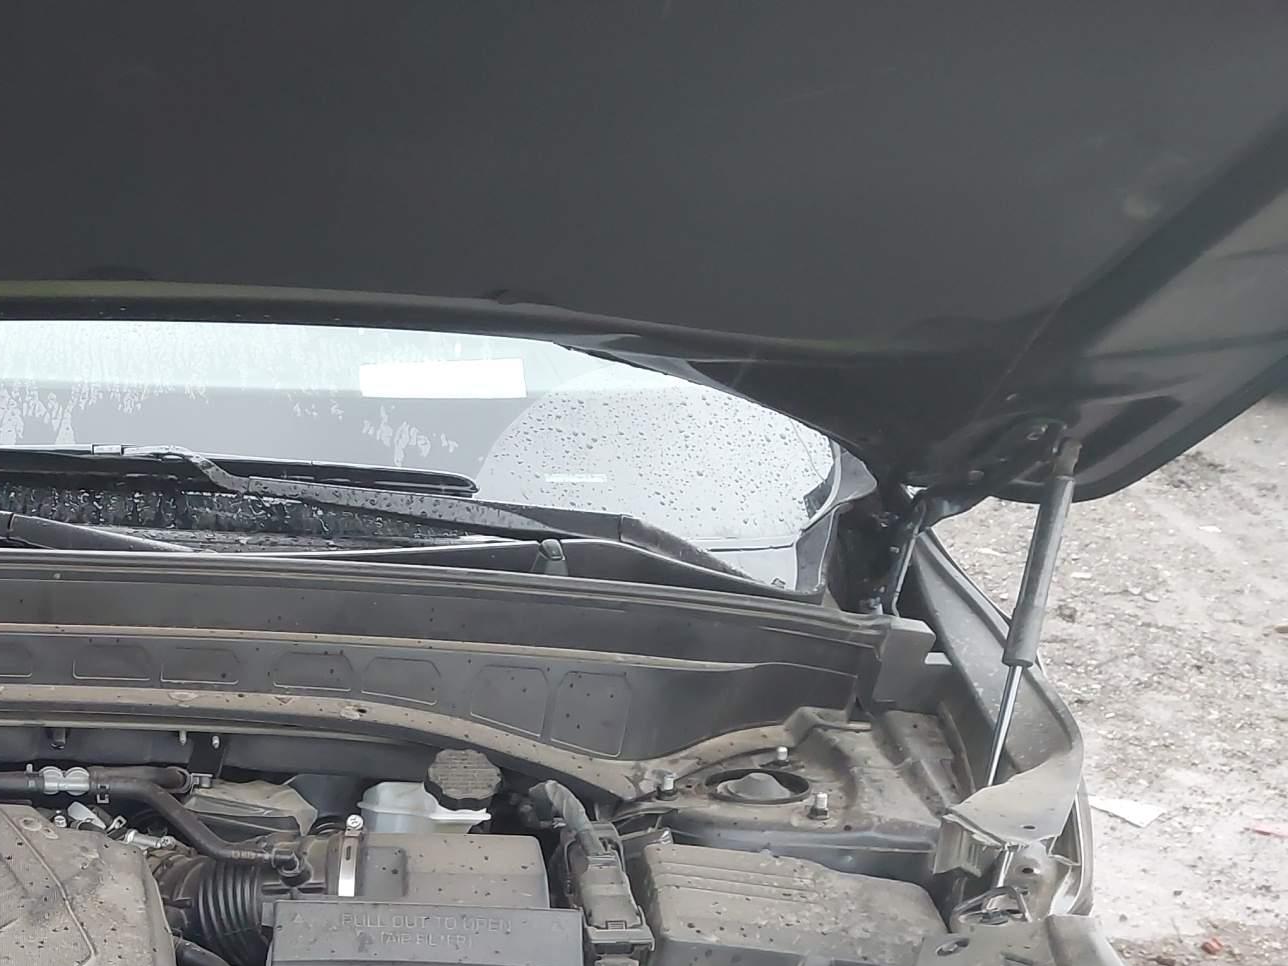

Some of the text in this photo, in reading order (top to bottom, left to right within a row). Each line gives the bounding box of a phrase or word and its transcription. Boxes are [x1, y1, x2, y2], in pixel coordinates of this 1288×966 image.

[341, 912, 387, 929] PULL
[391, 915, 426, 929] OUT
[432, 915, 457, 931] TO
